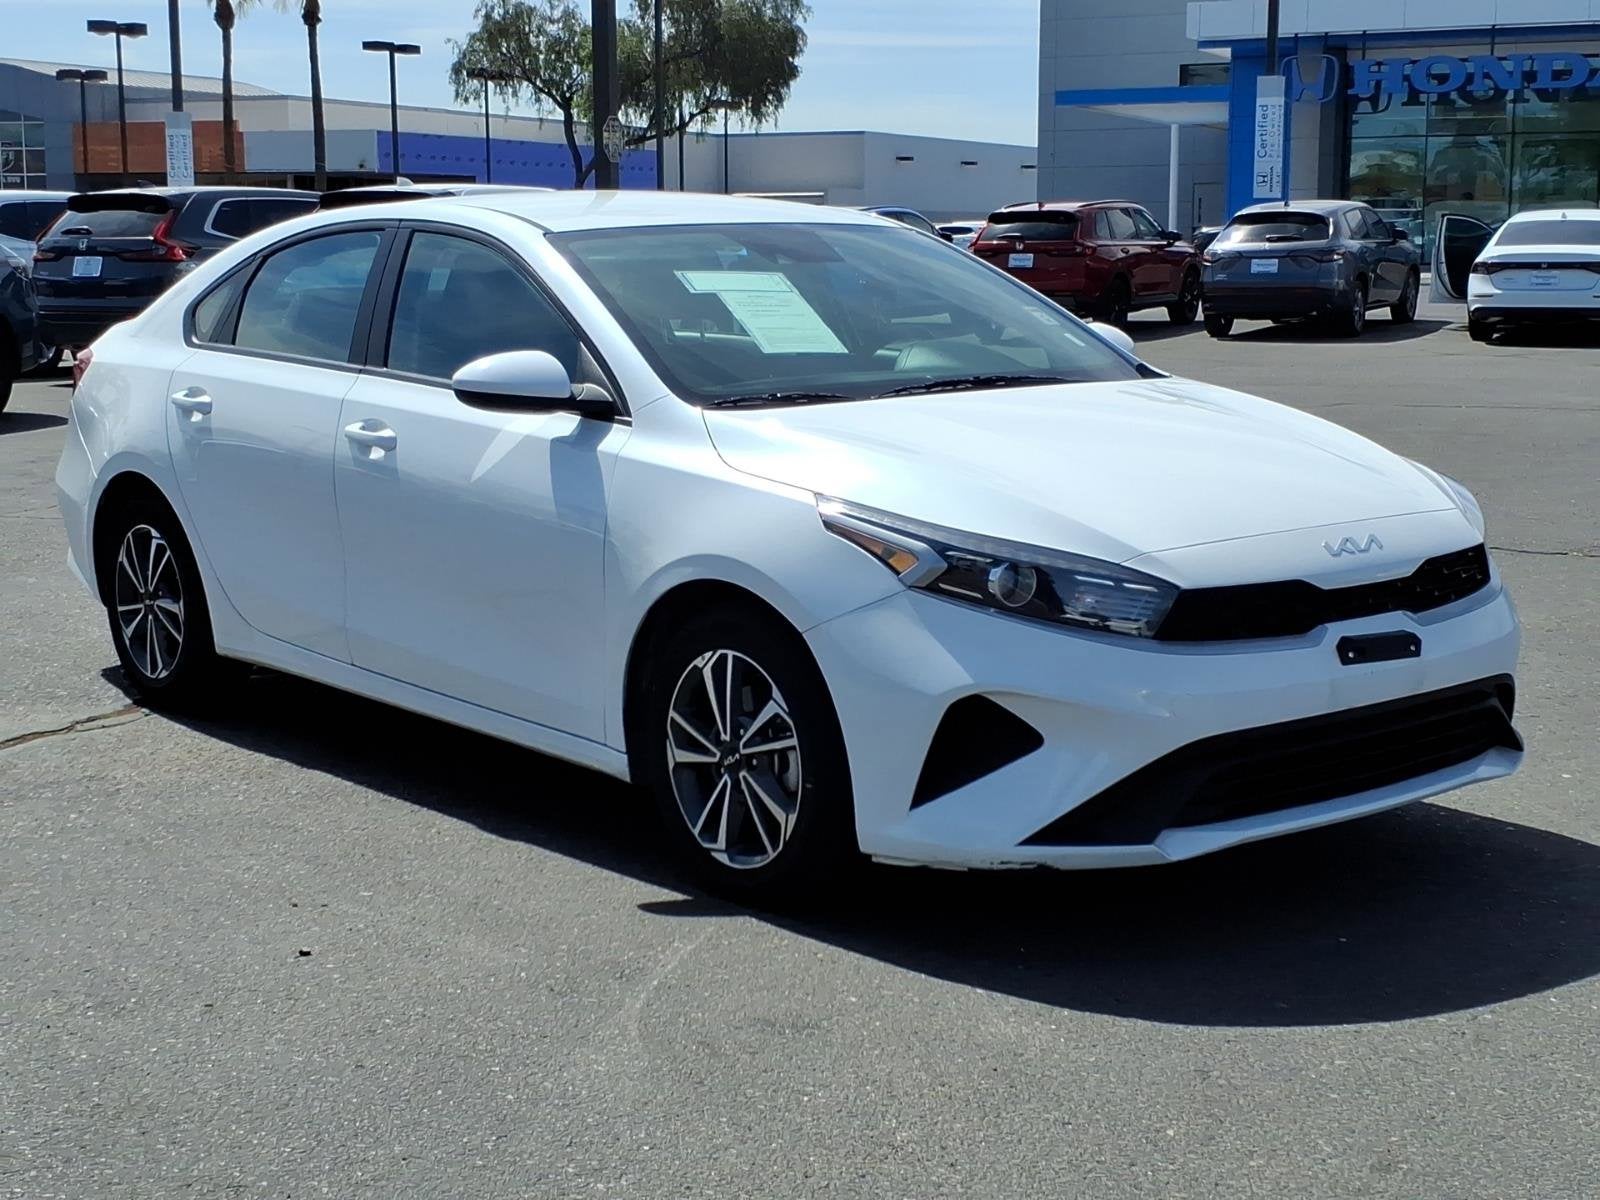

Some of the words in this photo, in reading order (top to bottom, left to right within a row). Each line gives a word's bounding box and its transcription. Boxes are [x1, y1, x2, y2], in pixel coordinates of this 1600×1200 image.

[1347, 52, 1600, 95] HOND
[1257, 104, 1269, 159] Certified
[1321, 533, 1384, 558] KIA
